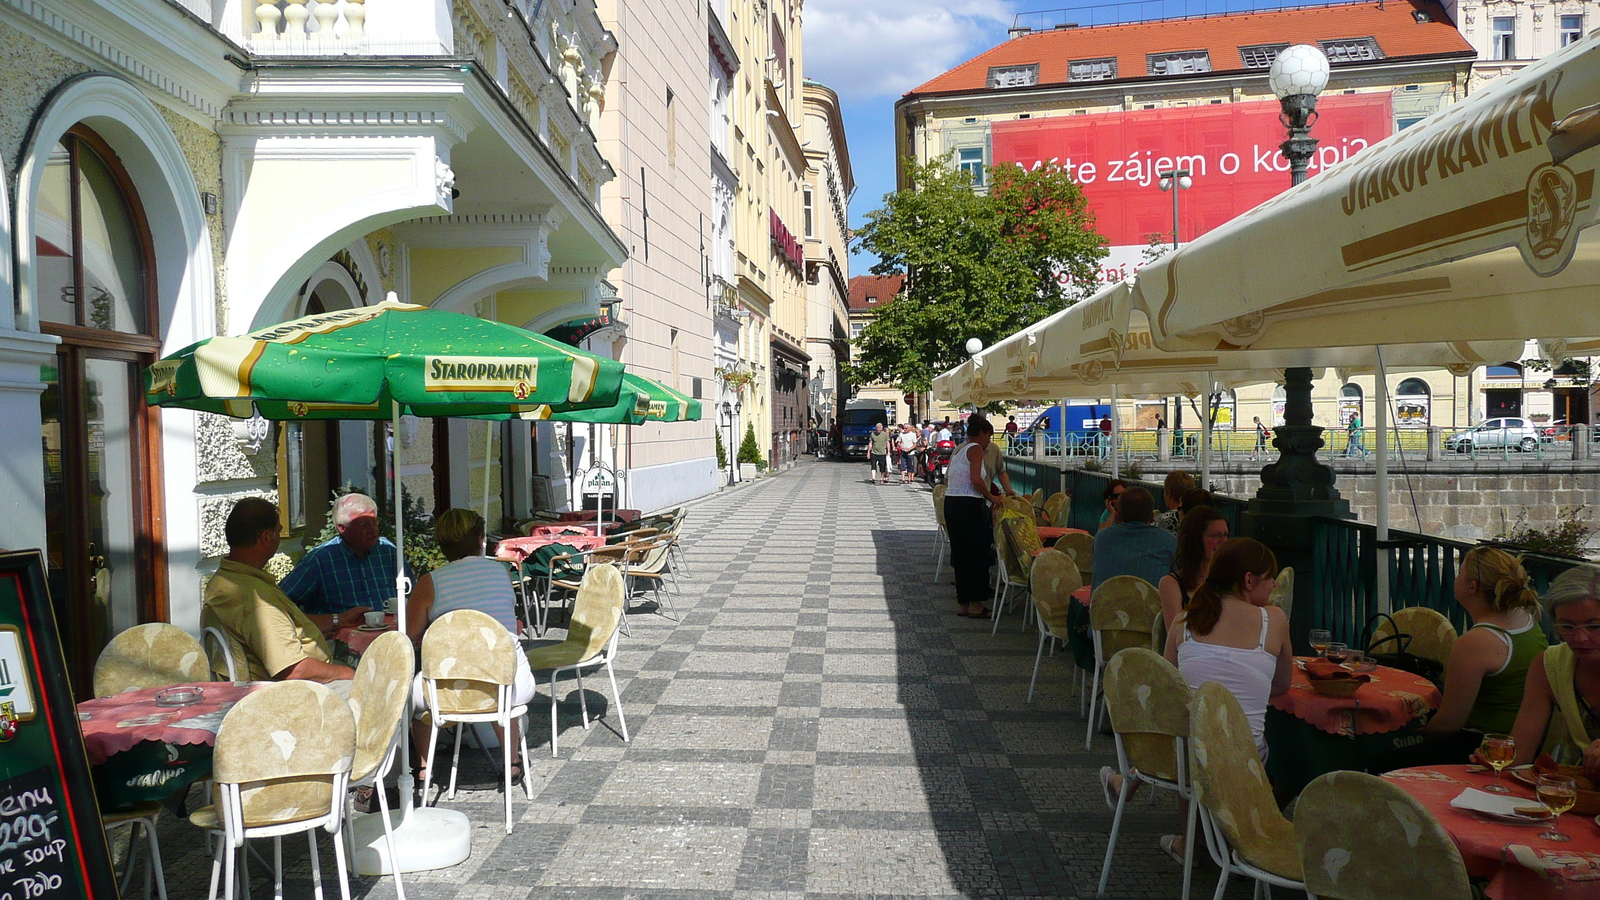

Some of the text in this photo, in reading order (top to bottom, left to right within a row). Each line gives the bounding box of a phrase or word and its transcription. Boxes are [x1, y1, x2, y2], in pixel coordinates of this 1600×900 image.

[1107, 151, 1207, 187] zájem
[1220, 153, 1241, 175] o
[431, 359, 533, 380] STAROPRAMEN
[588, 480, 610, 488] plaan
[0, 787, 53, 816] enu
[24, 839, 67, 866] soup
[13, 871, 62, 899] Pollo
